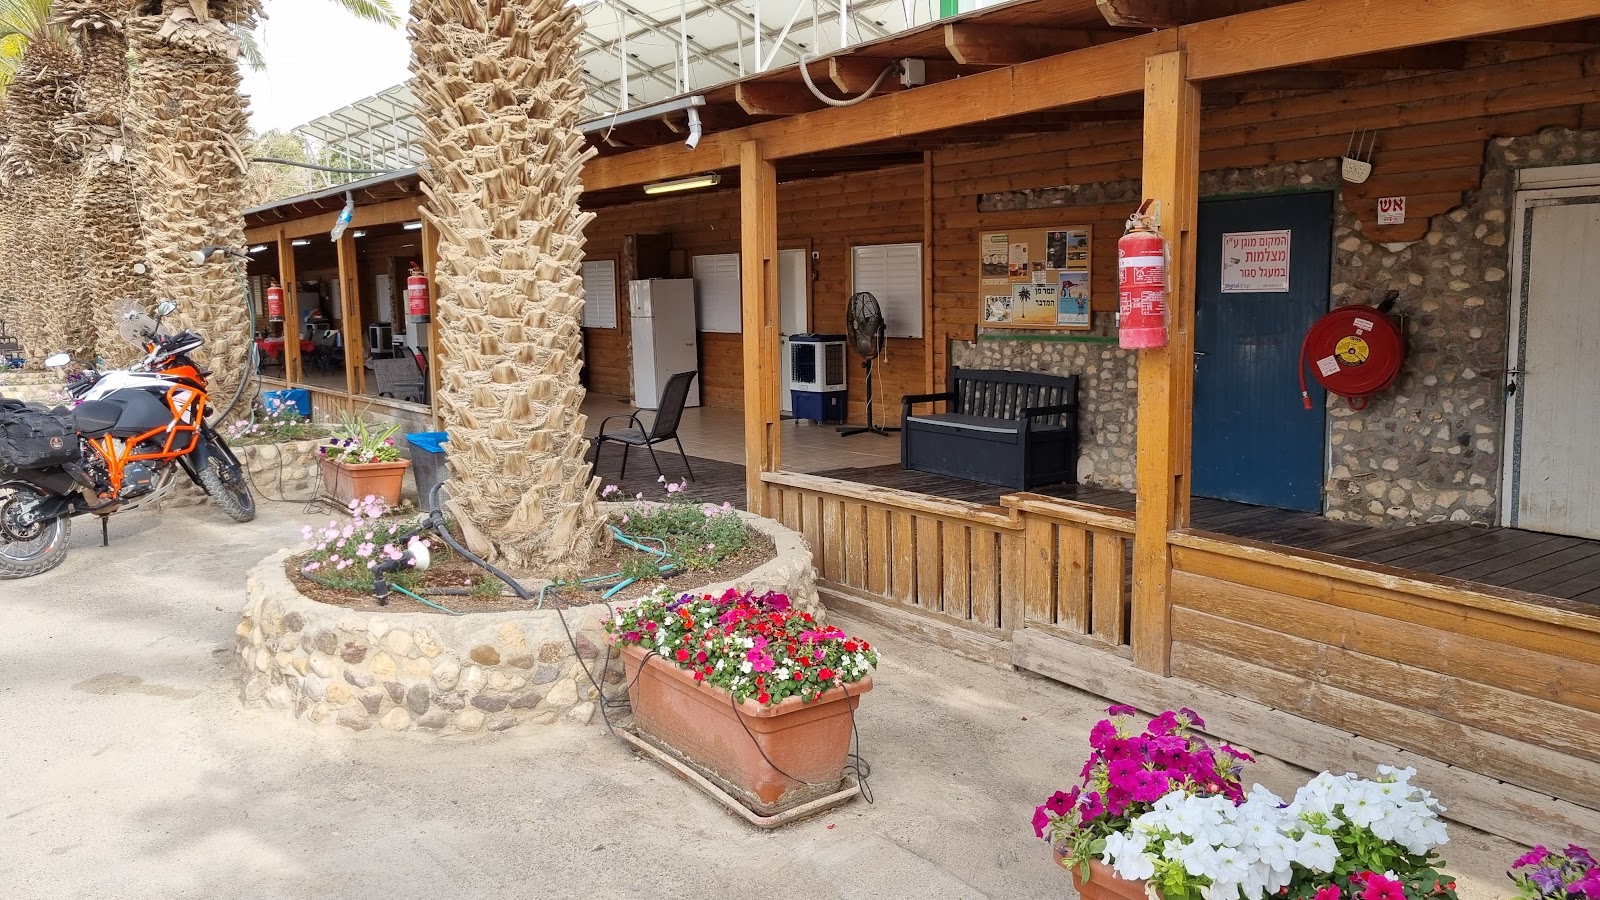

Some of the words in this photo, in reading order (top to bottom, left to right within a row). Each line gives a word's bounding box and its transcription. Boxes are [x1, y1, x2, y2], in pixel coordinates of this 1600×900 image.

[1380, 197, 1403, 212] אש
[1241, 238, 1257, 250] מוגן
[1259, 237, 1287, 248] המקום
[1245, 248, 1286, 262] מצלמות
[1240, 269, 1257, 278] סגור
[1259, 266, 1286, 278] במעגל
